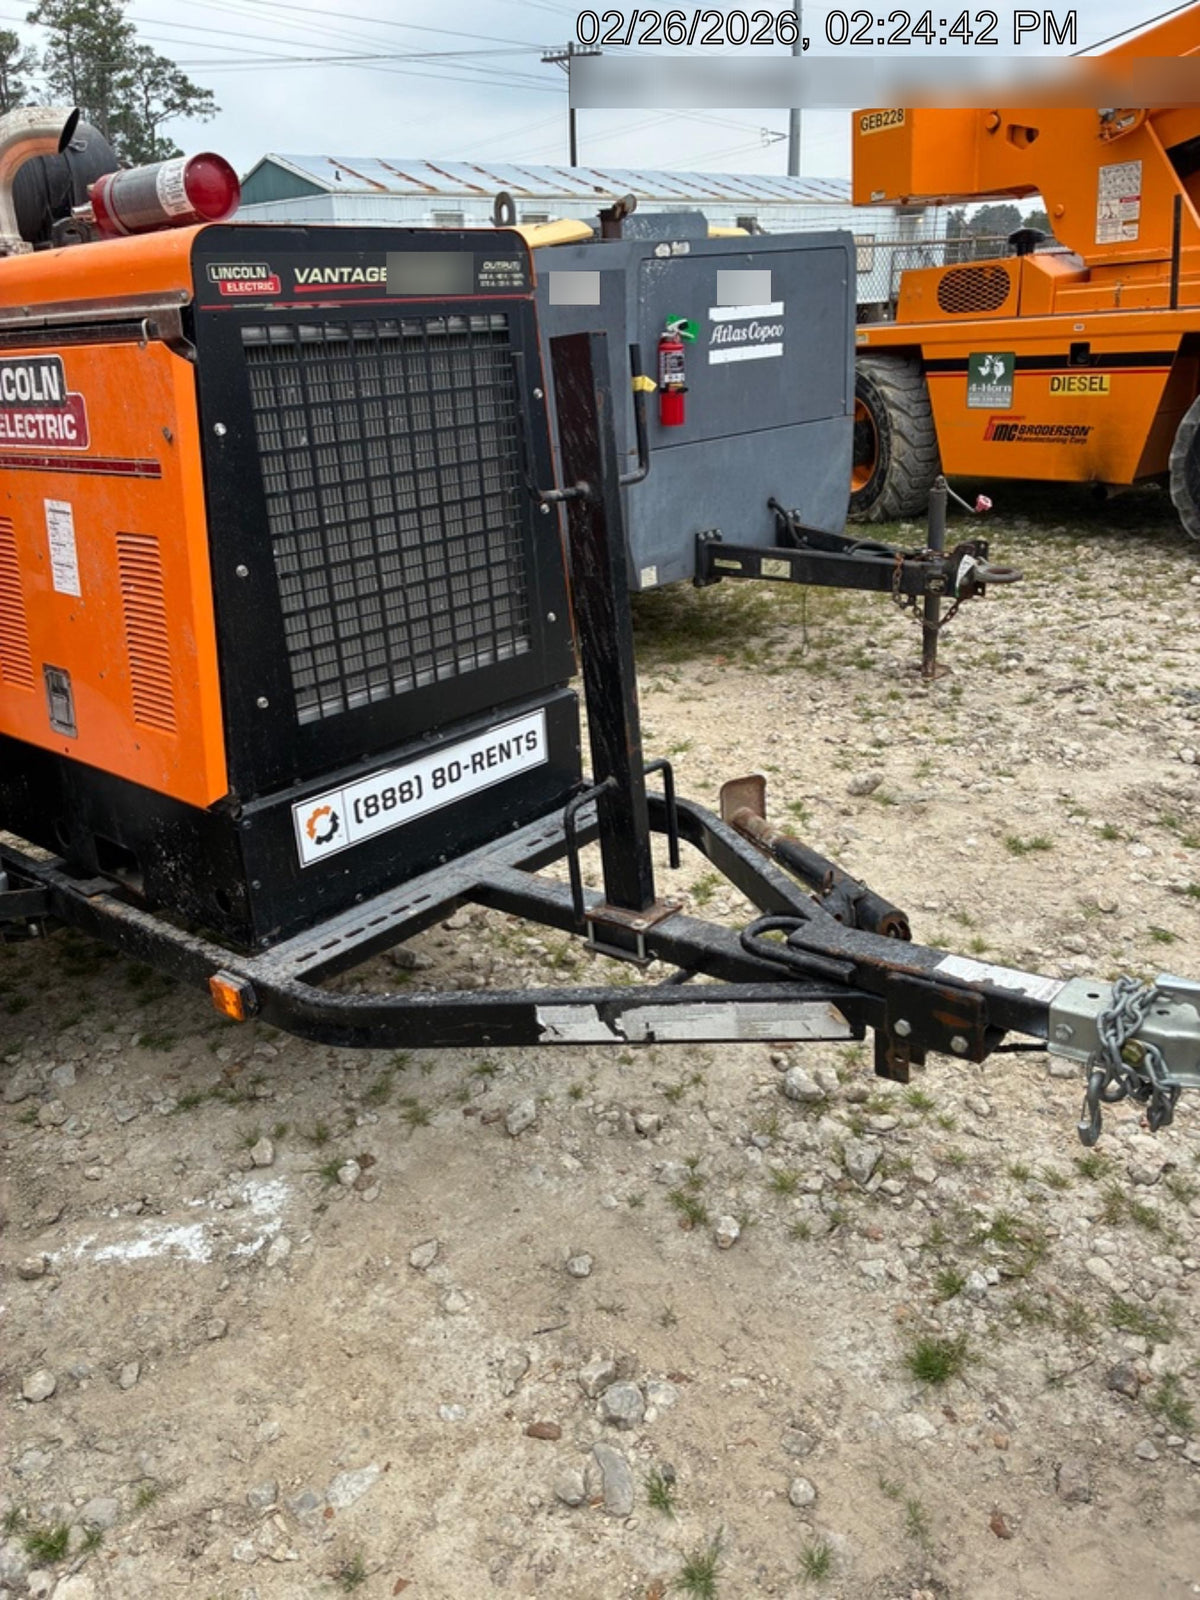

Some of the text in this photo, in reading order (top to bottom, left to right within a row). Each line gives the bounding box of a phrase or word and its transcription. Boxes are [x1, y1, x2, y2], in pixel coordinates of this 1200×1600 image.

[861, 108, 904, 131] GEB228
[211, 266, 267, 280] LINCOLN
[226, 282, 274, 292] ELECTRIC
[709, 321, 784, 345] Atlas Copco
[0, 366, 61, 401] COLN
[1050, 375, 1108, 392] DIESEL
[353, 730, 537, 824] (888) 80-RENTS
